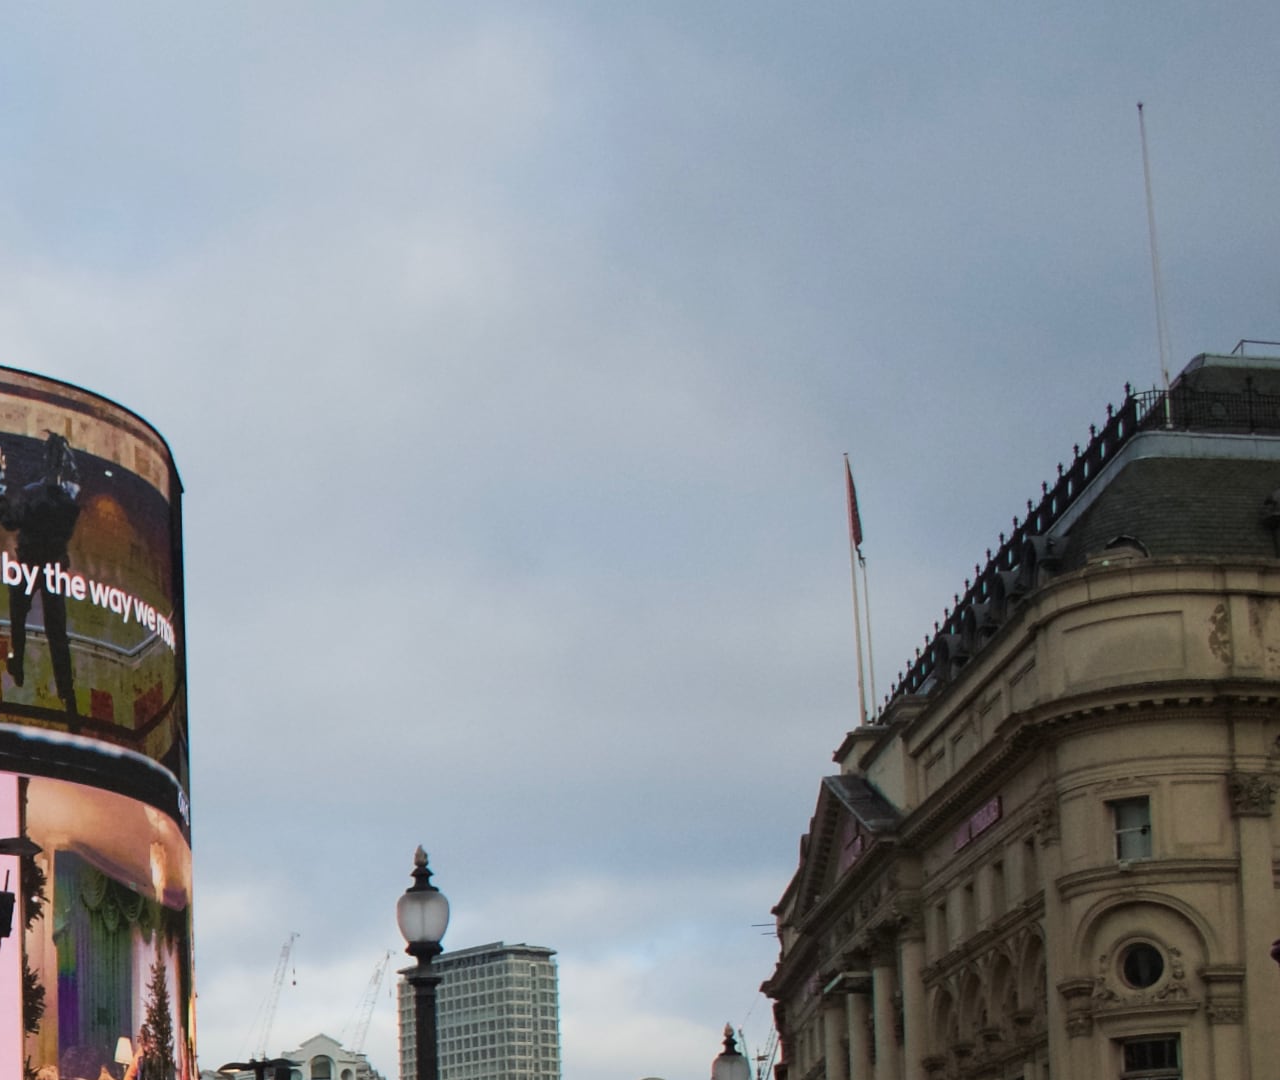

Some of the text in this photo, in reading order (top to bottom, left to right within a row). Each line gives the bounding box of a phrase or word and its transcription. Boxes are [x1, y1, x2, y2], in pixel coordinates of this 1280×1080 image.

[2, 551, 40, 596] by
[45, 561, 87, 601] the
[89, 581, 133, 624] way
[133, 598, 157, 633] we
